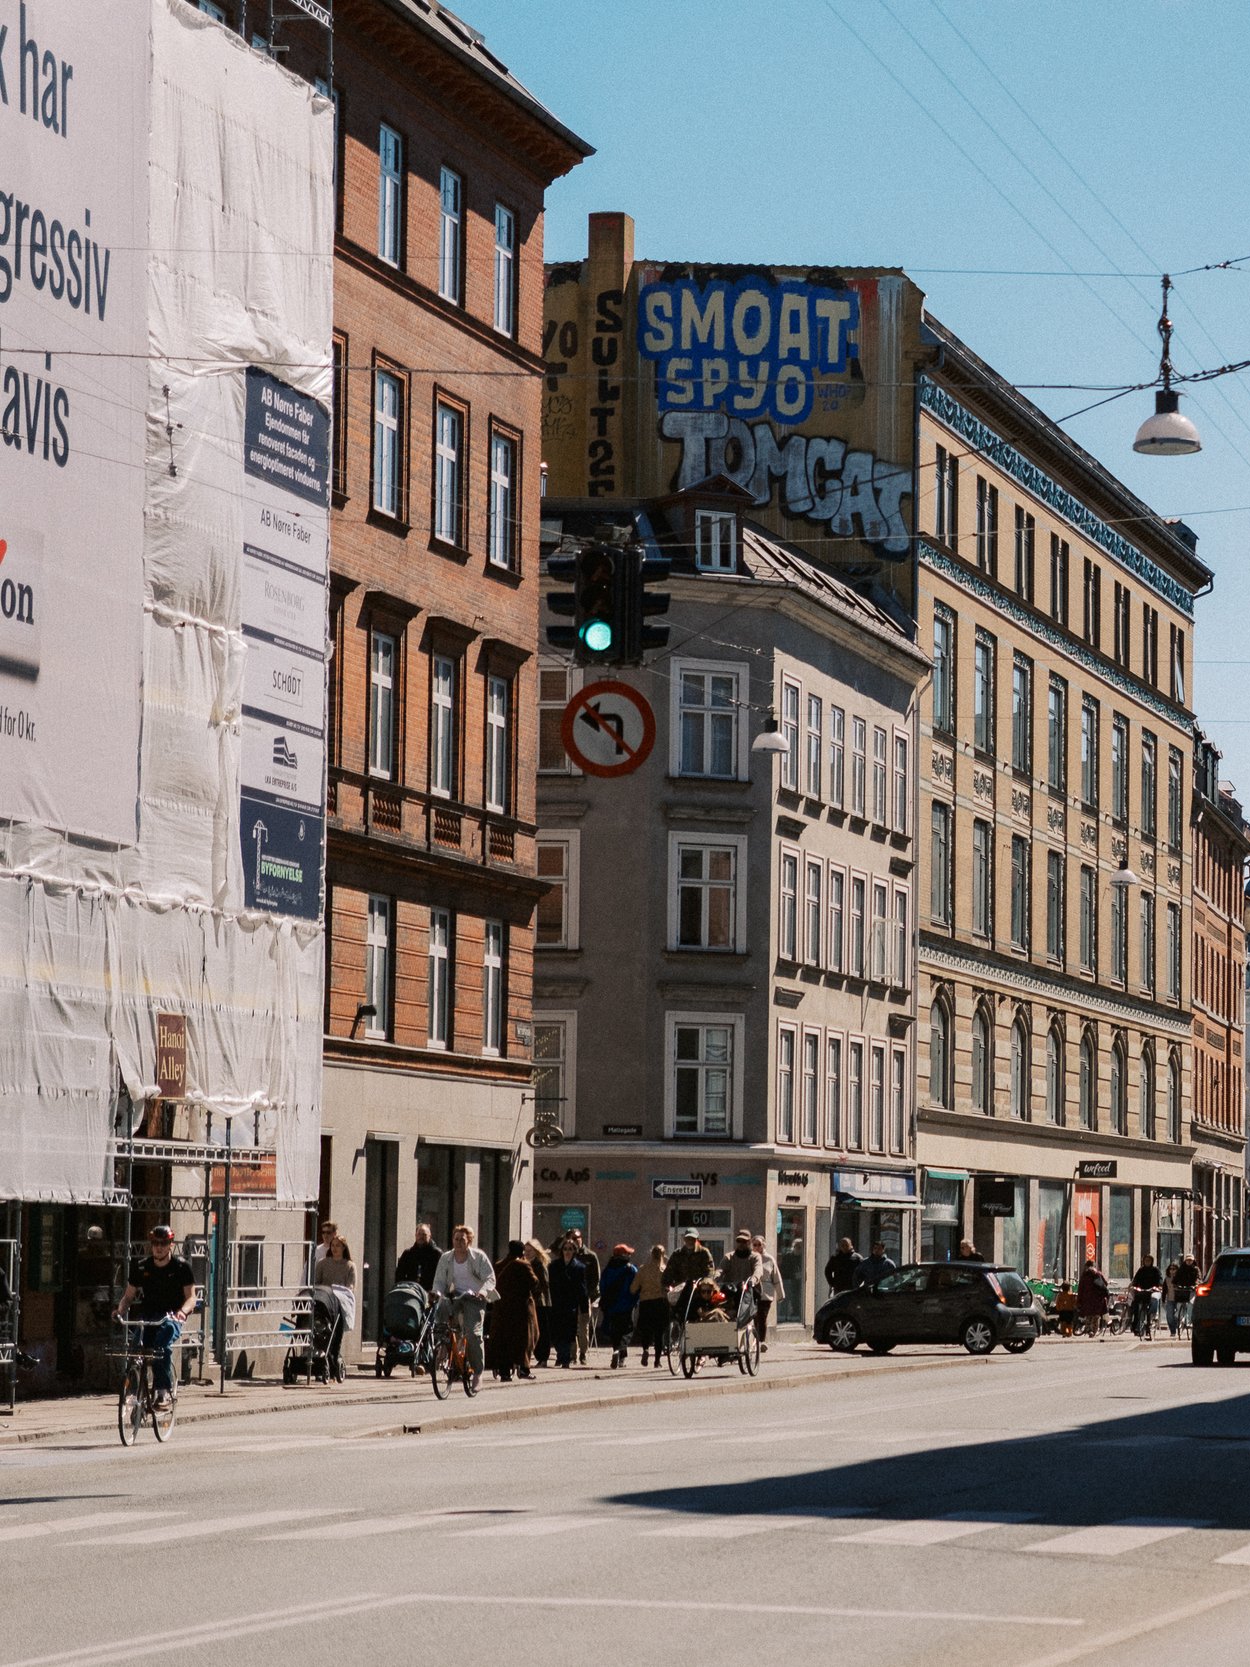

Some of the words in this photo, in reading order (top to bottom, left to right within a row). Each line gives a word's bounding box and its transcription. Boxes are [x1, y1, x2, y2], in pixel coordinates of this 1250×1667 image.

[20, 0, 73, 139] har
[643, 287, 851, 365] SMOAT
[665, 357, 807, 417] SPYO
[2, 352, 69, 468] avis
[261, 386, 273, 407] AB
[274, 392, 294, 417] Nørre
[294, 403, 314, 427] Faber
[265, 412, 302, 442] Ejendommen
[258, 432, 285, 456] renoveret
[286, 443, 308, 466] facaden
[308, 457, 316, 472] og
[250, 449, 294, 480] energioptimeret
[294, 469, 322, 493] vinduerne.
[660, 411, 912, 554] TOMCAT
[260, 508, 271, 527] AB
[273, 515, 291, 537] Nørre
[292, 523, 311, 545] Faber
[4, 706, 17, 737] for
[18, 710, 24, 739] 0
[26, 712, 36, 742] kr.
[261, 860, 303, 883] BYFORNYELSE
[159, 1025, 185, 1049] Hanoi
[159, 1055, 185, 1087] Alley
[540, 1168, 561, 1181] Co.
[564, 1167, 590, 1185] ApS
[662, 1184, 699, 1194] Ensrettet
[692, 1212, 707, 1225] 60
